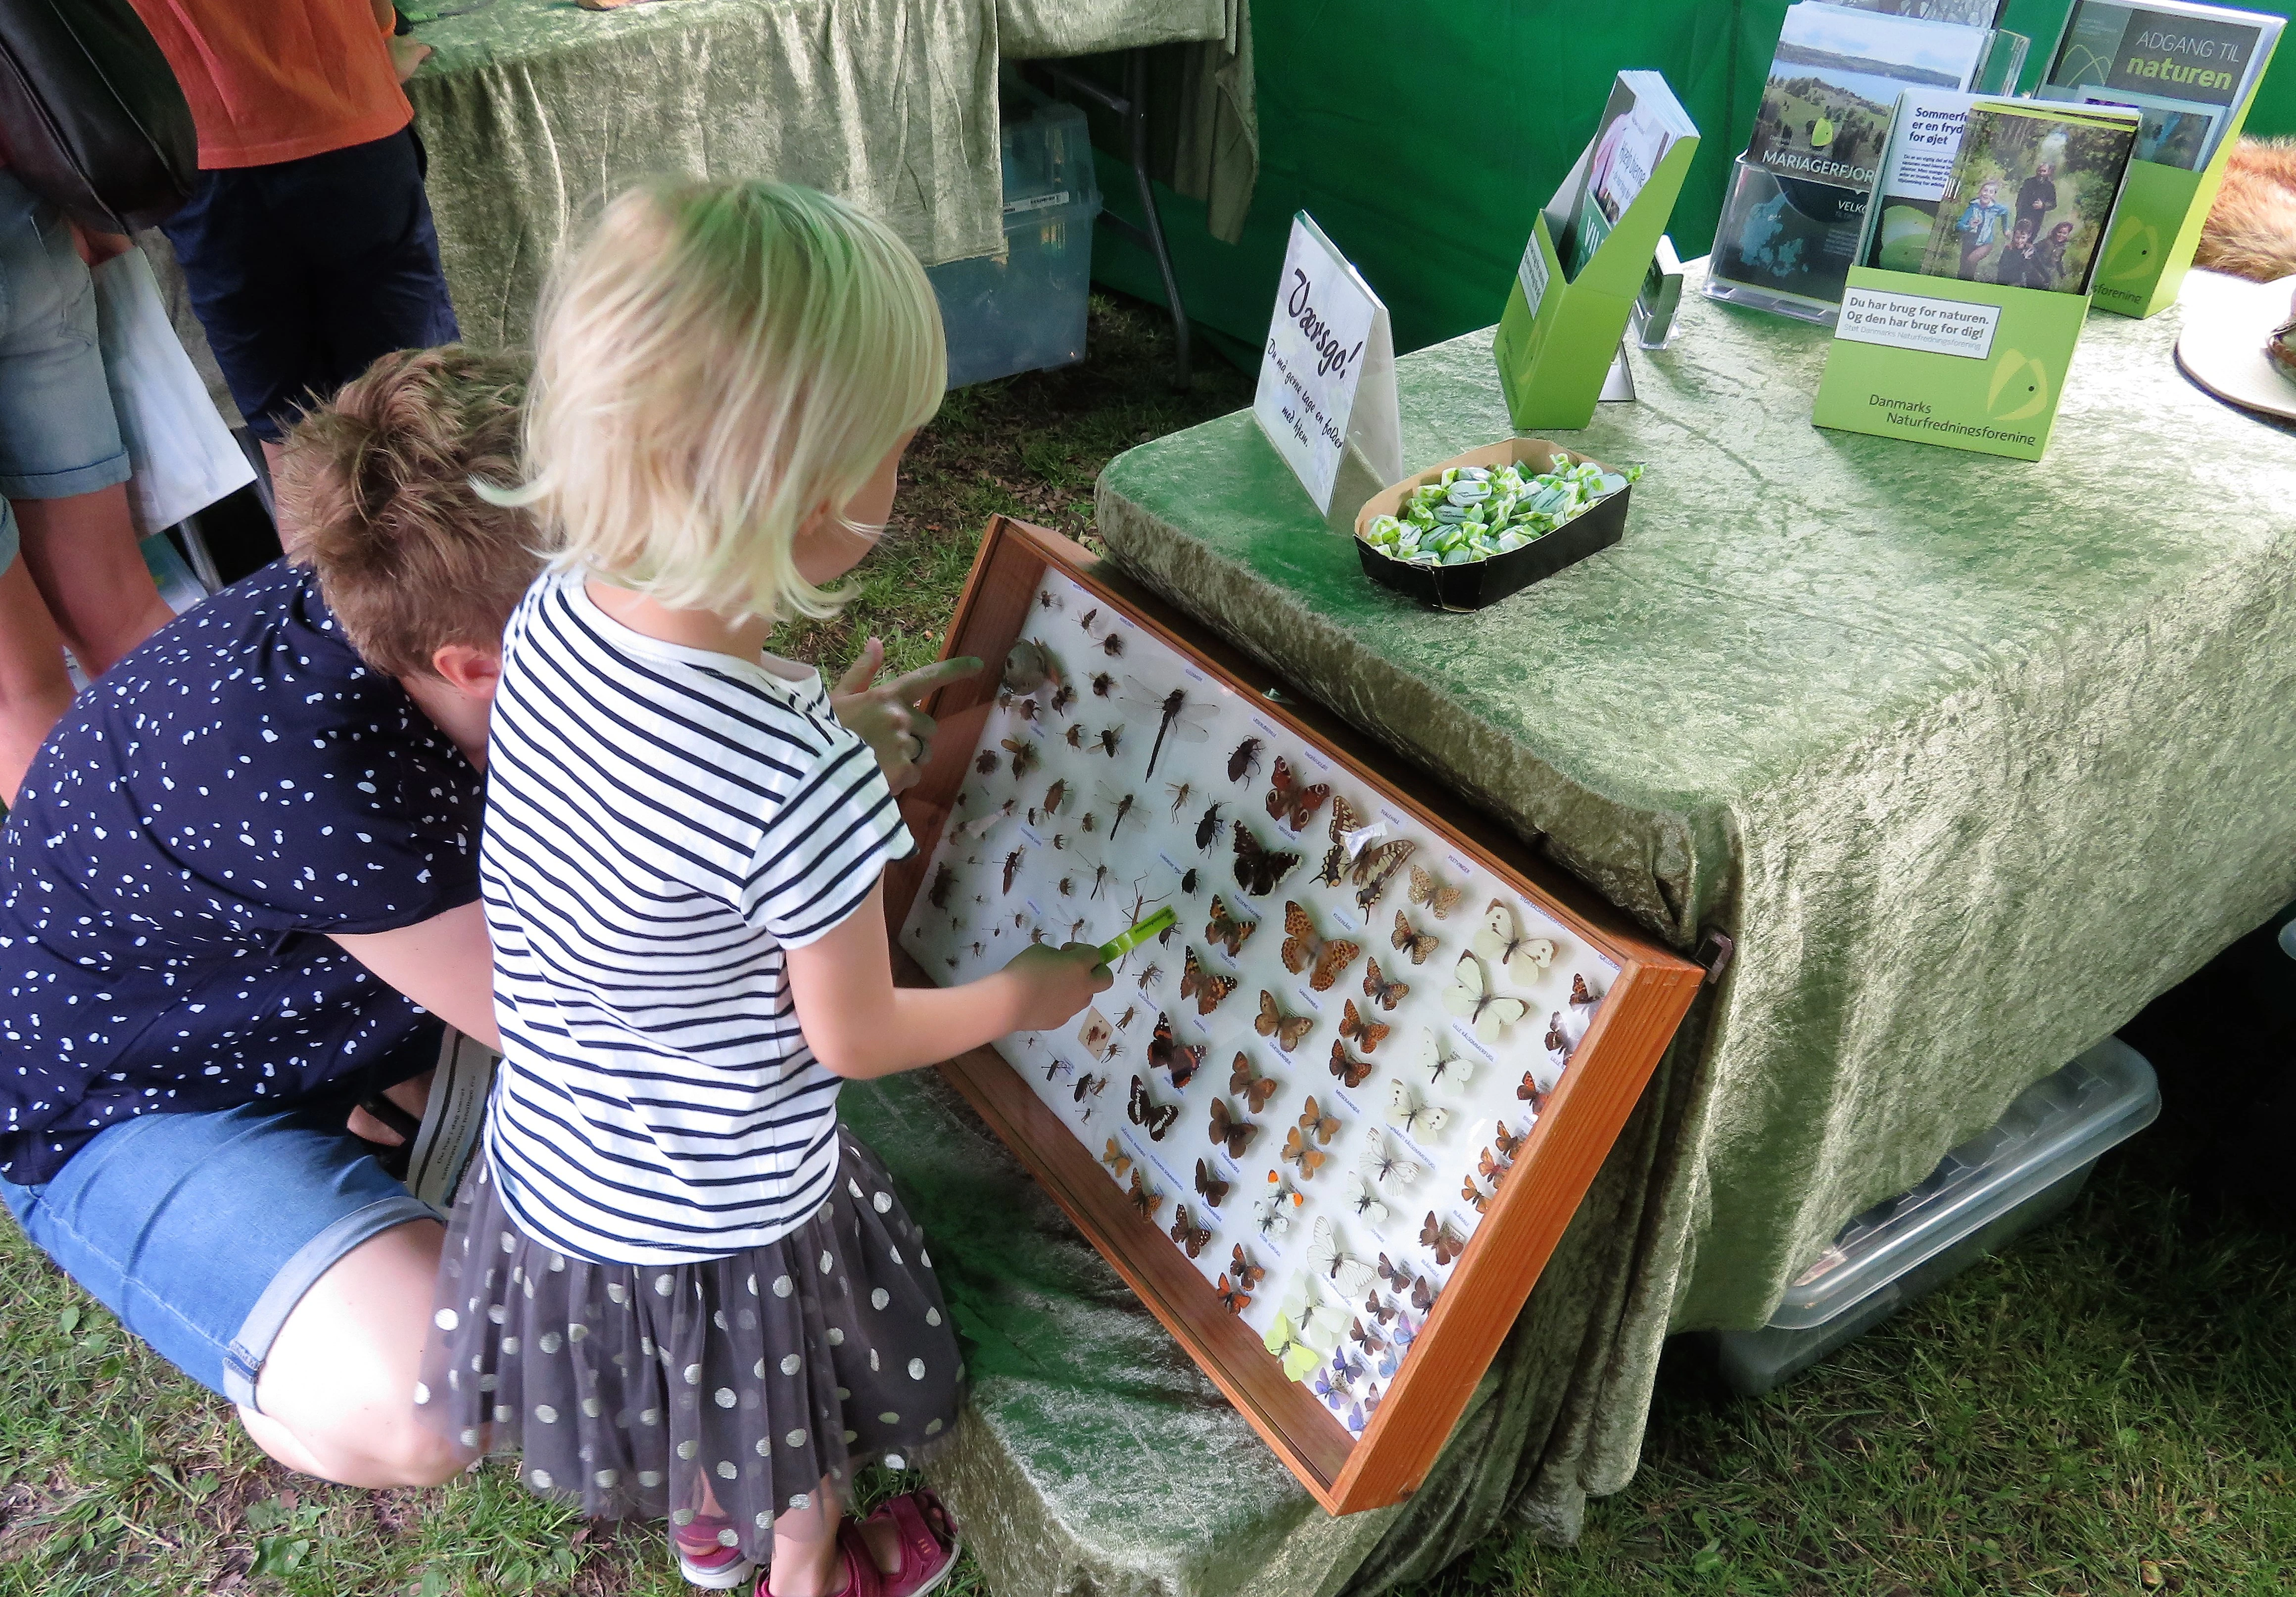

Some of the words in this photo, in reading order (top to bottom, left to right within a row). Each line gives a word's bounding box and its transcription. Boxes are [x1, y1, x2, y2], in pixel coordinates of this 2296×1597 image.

[2136, 32, 2214, 58] ADGANG
[2219, 42, 2240, 63] TIL
[2127, 57, 2233, 91] naturen
[1909, 131, 1925, 142] for
[1927, 135, 1948, 145] øjet
[1912, 121, 1924, 130] er
[1925, 123, 1938, 132] en
[1941, 122, 1964, 136] fryd
[1762, 150, 1874, 184] MARIAGERFJOR
[1288, 268, 1363, 379] Værsgo!
[1847, 311, 1864, 323] Og
[1865, 314, 1886, 325] den
[1889, 316, 1909, 328] har
[1911, 320, 1938, 334] brug
[1941, 323, 1959, 334] for
[1961, 326, 1984, 340] dig!
[1849, 296, 1865, 308] Du
[1867, 299, 1887, 311] har
[1889, 303, 1916, 317] brug
[1919, 306, 1937, 318] for
[1939, 310, 1989, 325] naturen.
[1861, 325, 1896, 338] Danmarks
[1268, 338, 1277, 361] Du
[1276, 357, 1287, 374] må
[1285, 372, 1302, 395] gerne
[1302, 390, 1315, 415] tage
[1315, 411, 1324, 424] en
[1322, 417, 1343, 449] folder
[1869, 394, 1932, 414] Danmarks
[1281, 405, 1295, 424] med
[1293, 418, 1309, 448] hjem.
[1886, 412, 2036, 446] Naturfredningsforening
[1448, 855, 1470, 874] PLETVINGER
[1452, 1023, 1462, 1033] LILLE
[1461, 1030, 1495, 1063] KÅLSOMMERFUGL
[1404, 1138, 1436, 1171] KÅLSOMMERFUGL
